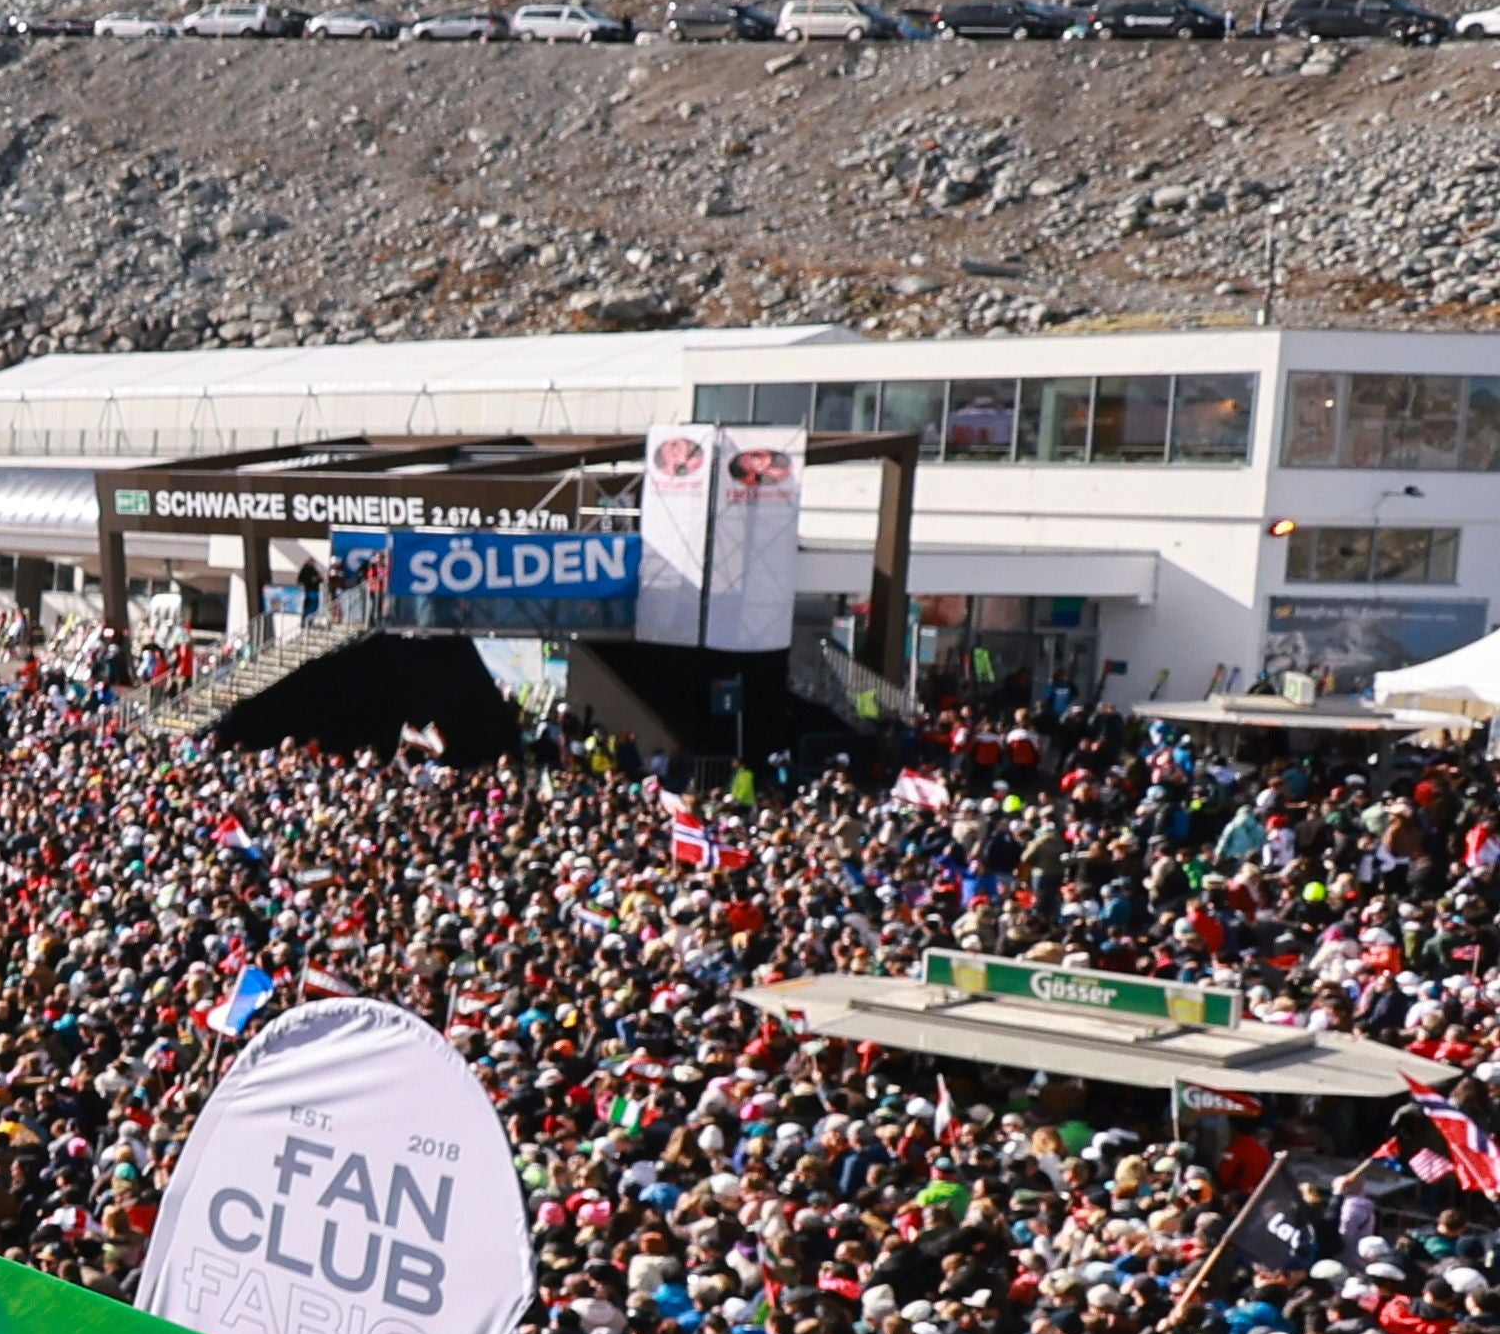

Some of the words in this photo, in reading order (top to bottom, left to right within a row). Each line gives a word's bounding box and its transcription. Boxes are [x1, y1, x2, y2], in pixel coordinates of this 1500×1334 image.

[155, 489, 287, 522] SCHWARZE
[293, 495, 426, 525] SCHNEIDE
[430, 506, 482, 528] 2.674
[409, 537, 626, 595] SÖLDEN
[1030, 970, 1117, 1006] Gösser
[289, 1105, 333, 1132] EST.
[407, 1135, 460, 1162] 2018
[274, 1134, 454, 1243] FAN
[208, 1187, 446, 1316] CLUB
